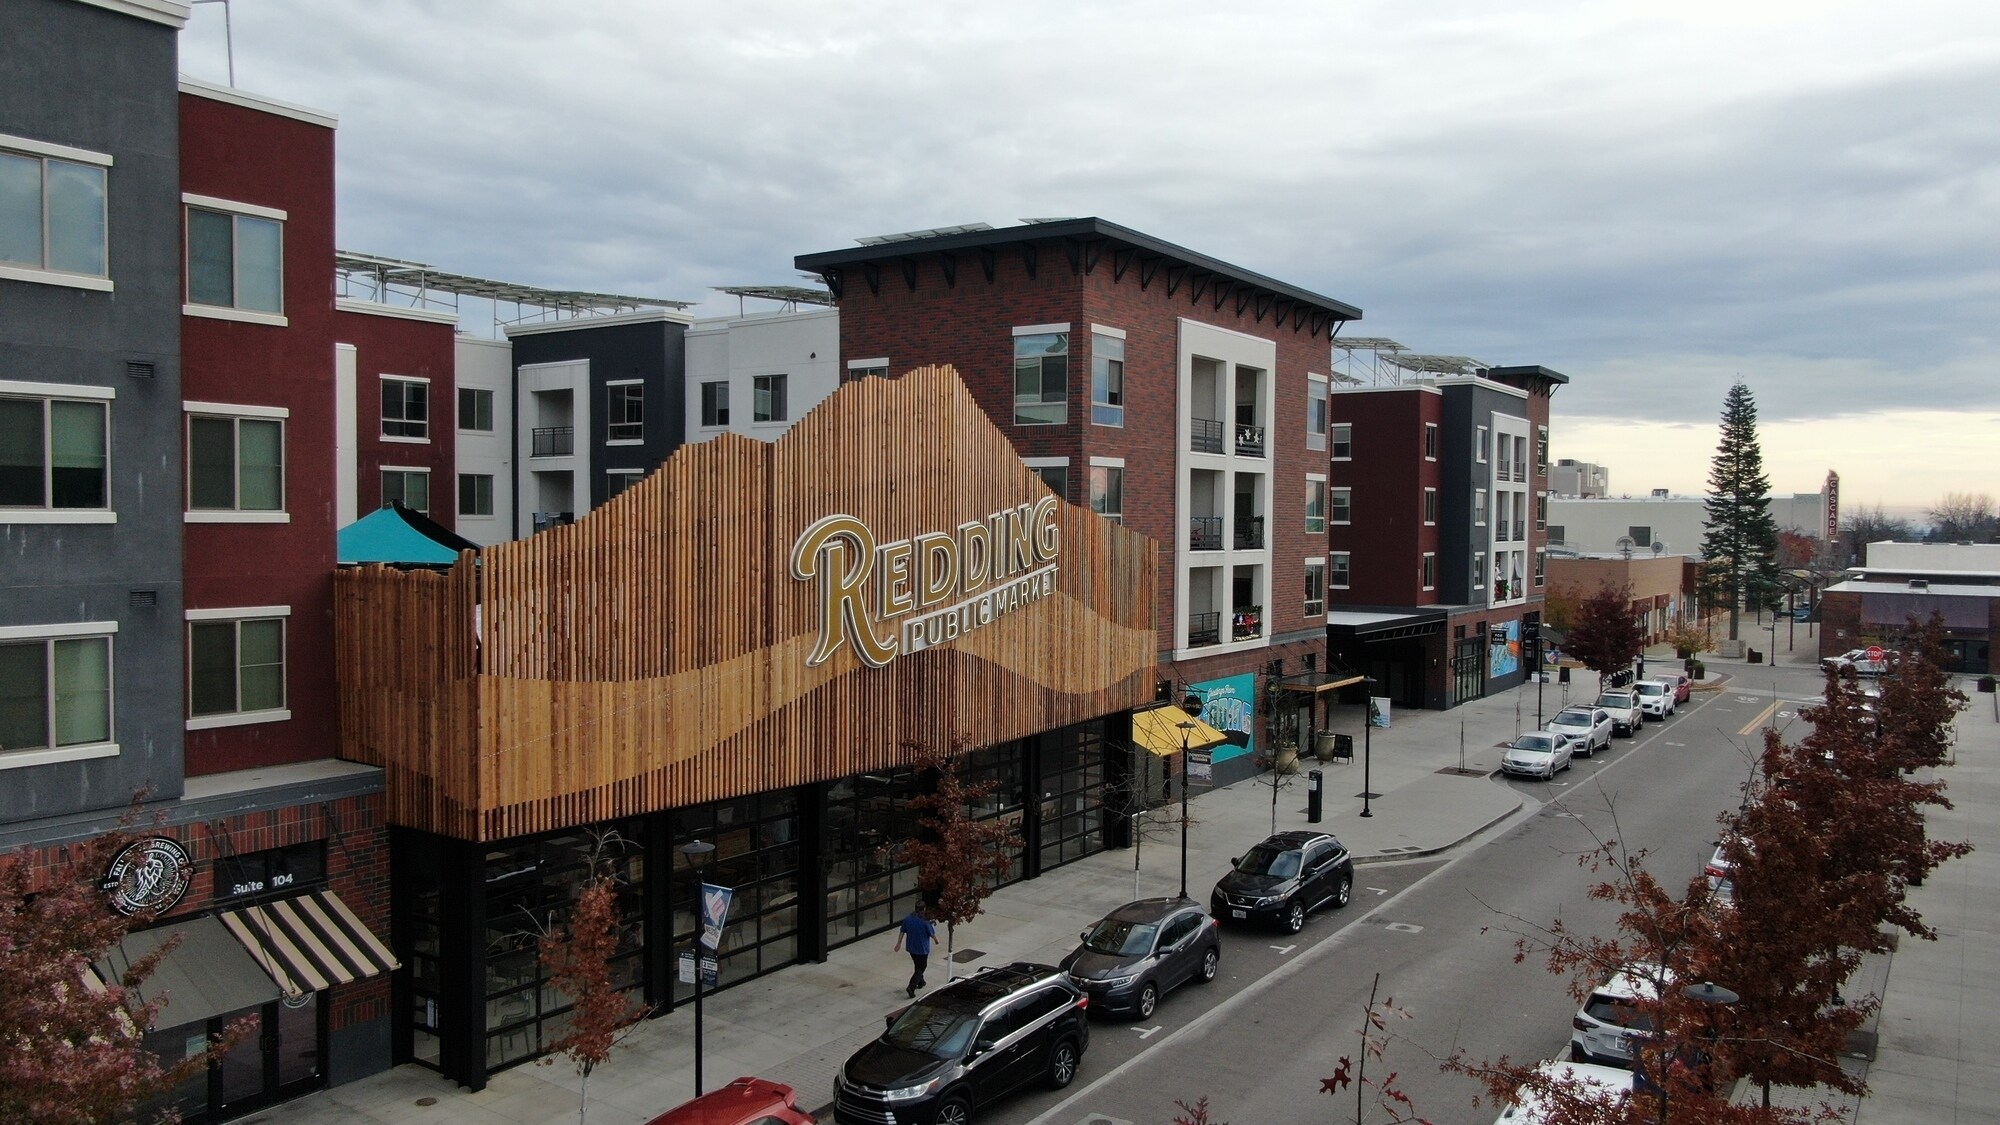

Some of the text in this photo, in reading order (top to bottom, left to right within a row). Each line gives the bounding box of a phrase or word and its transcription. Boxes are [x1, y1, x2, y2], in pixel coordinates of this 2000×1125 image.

[1829, 481, 1837, 535] CASCADE
[790, 494, 1060, 668] REDDING
[910, 567, 1060, 652] PUBLIC MARKET
[103, 881, 119, 889] ESTD
[233, 873, 293, 895] Suite 104
